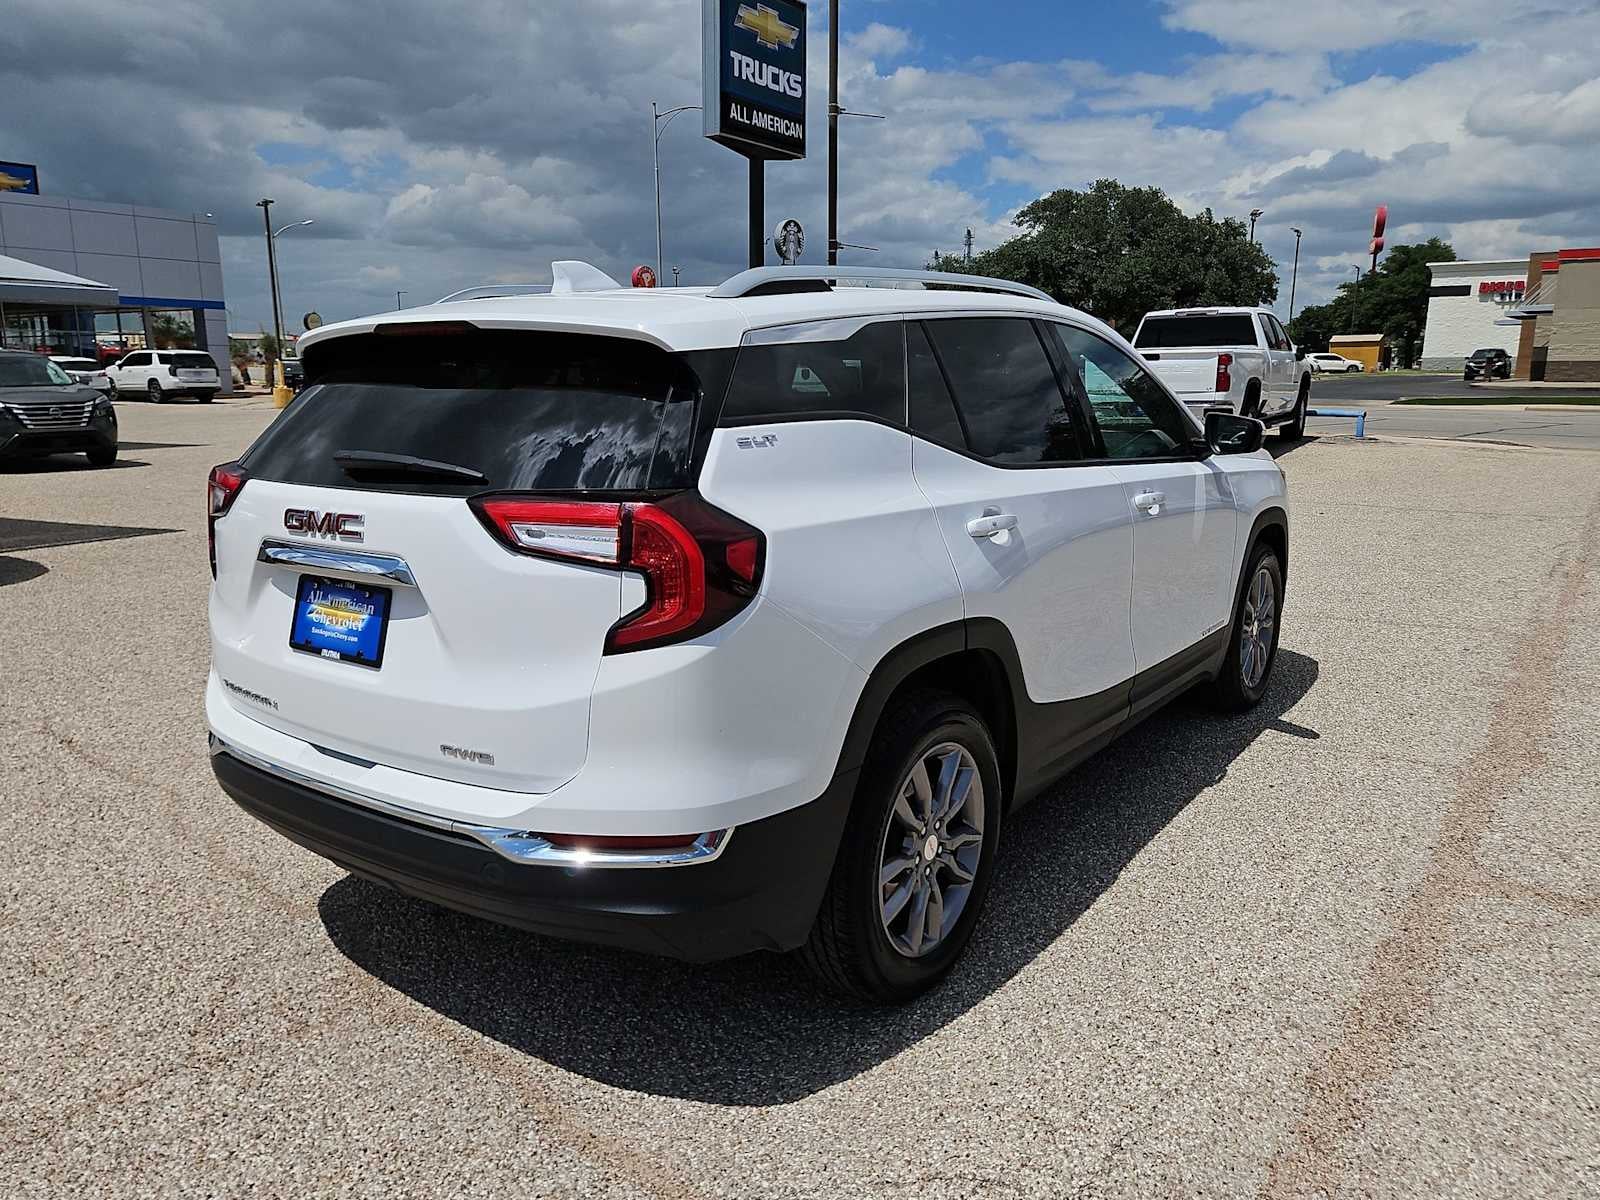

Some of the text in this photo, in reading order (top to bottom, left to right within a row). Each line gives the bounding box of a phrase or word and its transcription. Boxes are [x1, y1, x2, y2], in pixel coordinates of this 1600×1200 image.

[730, 50, 802, 98] TRUCKS
[729, 103, 803, 139] ALL AMERICAN
[284, 508, 364, 541] GMC
[306, 590, 375, 615] All American
[312, 608, 364, 632] Chevrolet
